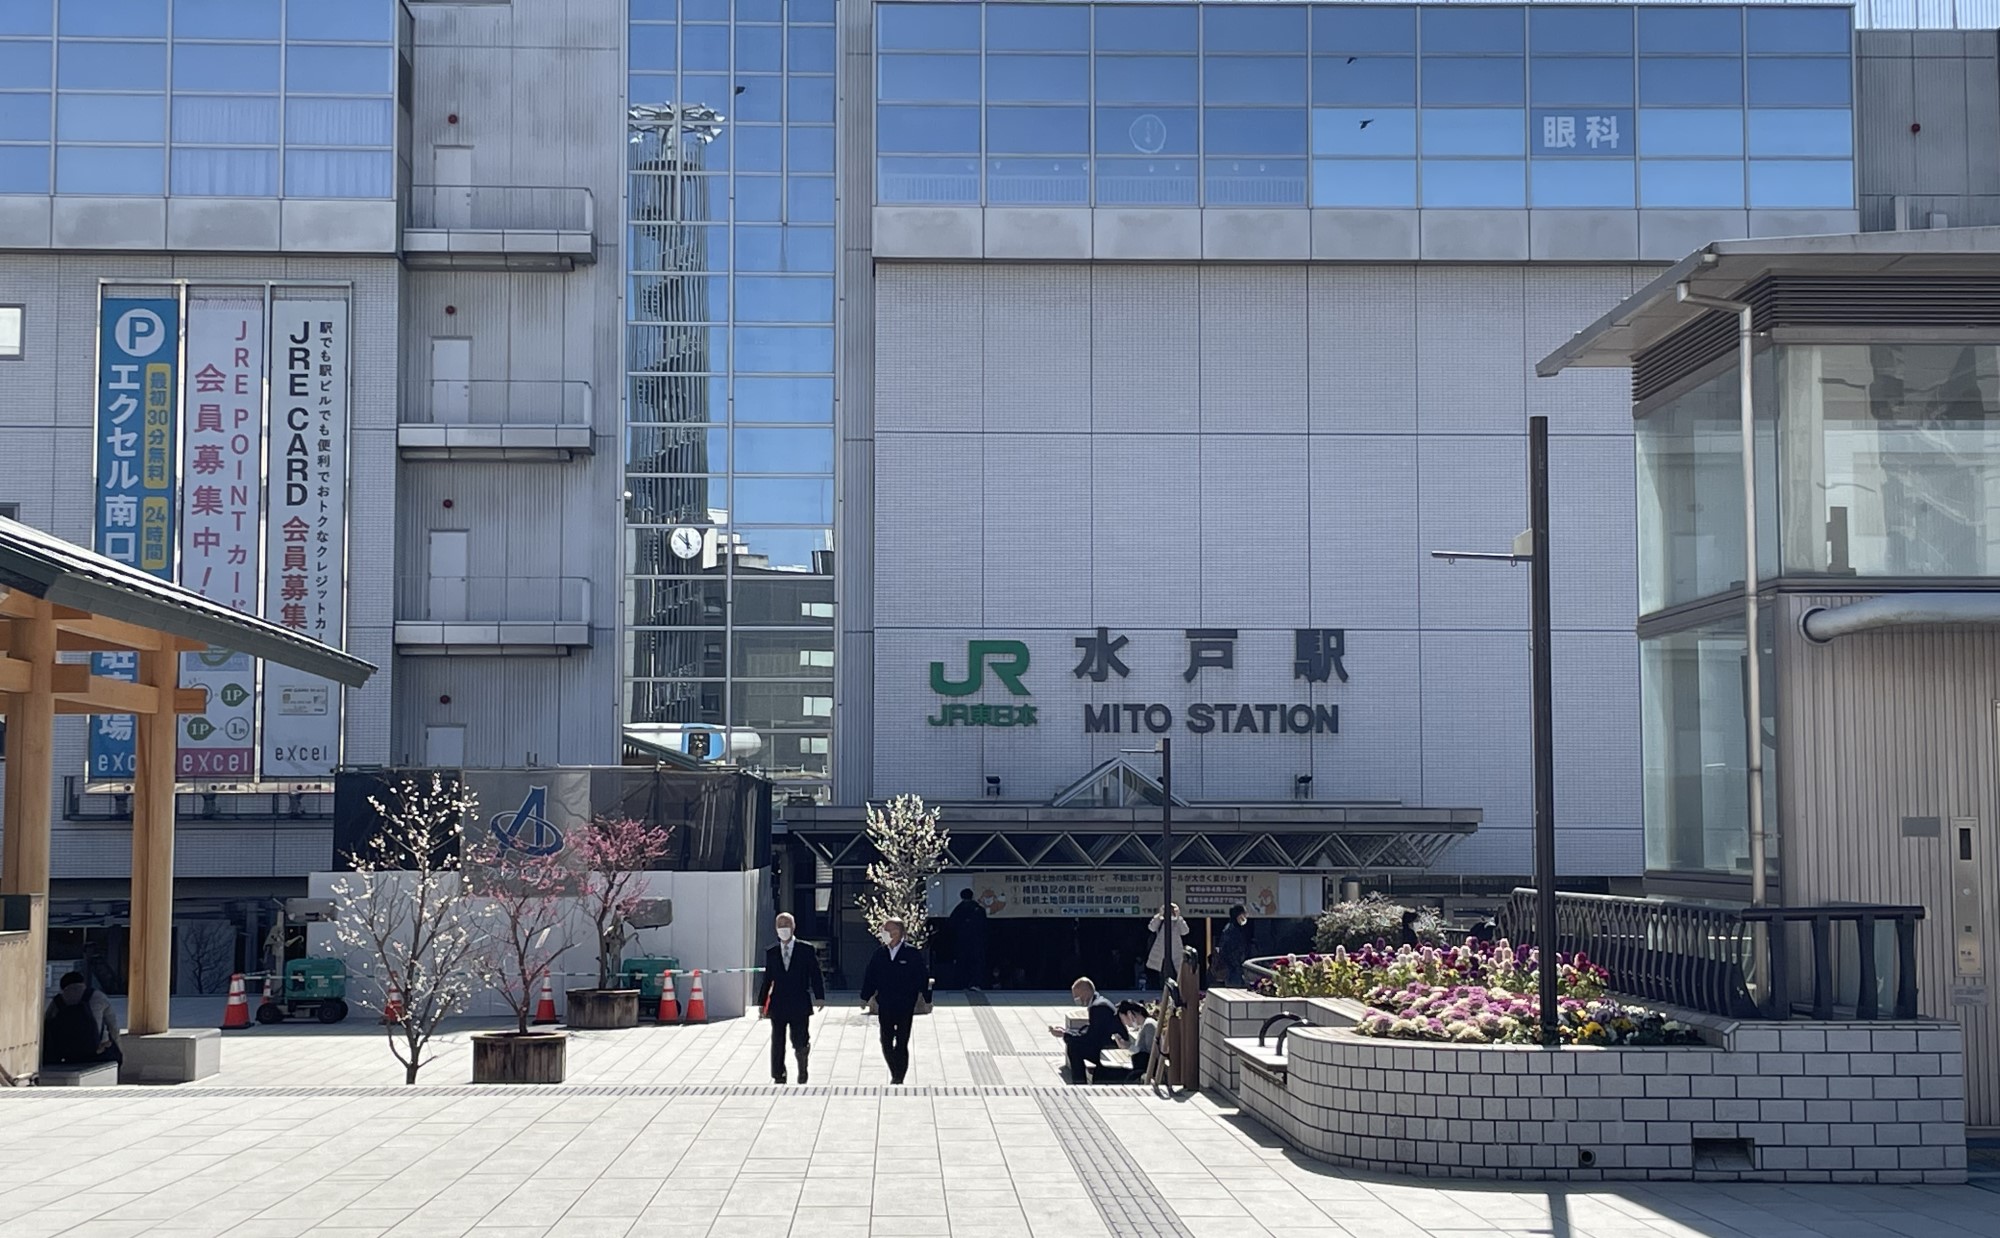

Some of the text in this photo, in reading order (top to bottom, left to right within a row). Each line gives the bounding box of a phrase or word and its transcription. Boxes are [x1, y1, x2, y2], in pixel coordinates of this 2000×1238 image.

[1543, 115, 1620, 149] 眼科
[128, 316, 156, 350] P
[234, 320, 250, 395] JRE
[105, 364, 140, 563] エクセル南口
[230, 408, 250, 532] POINT
[280, 321, 311, 630] JRE CARD 会員募集
[144, 506, 166, 561] 24時間
[930, 640, 1031, 697] JR
[1073, 627, 1349, 683] 水戸駅
[225, 689, 243, 701] 1P
[191, 723, 210, 735] 1P
[928, 704, 1038, 727] JR東日本
[1085, 704, 1339, 734] MITO STATION
[182, 751, 248, 772] excel
[275, 745, 328, 762] excel
